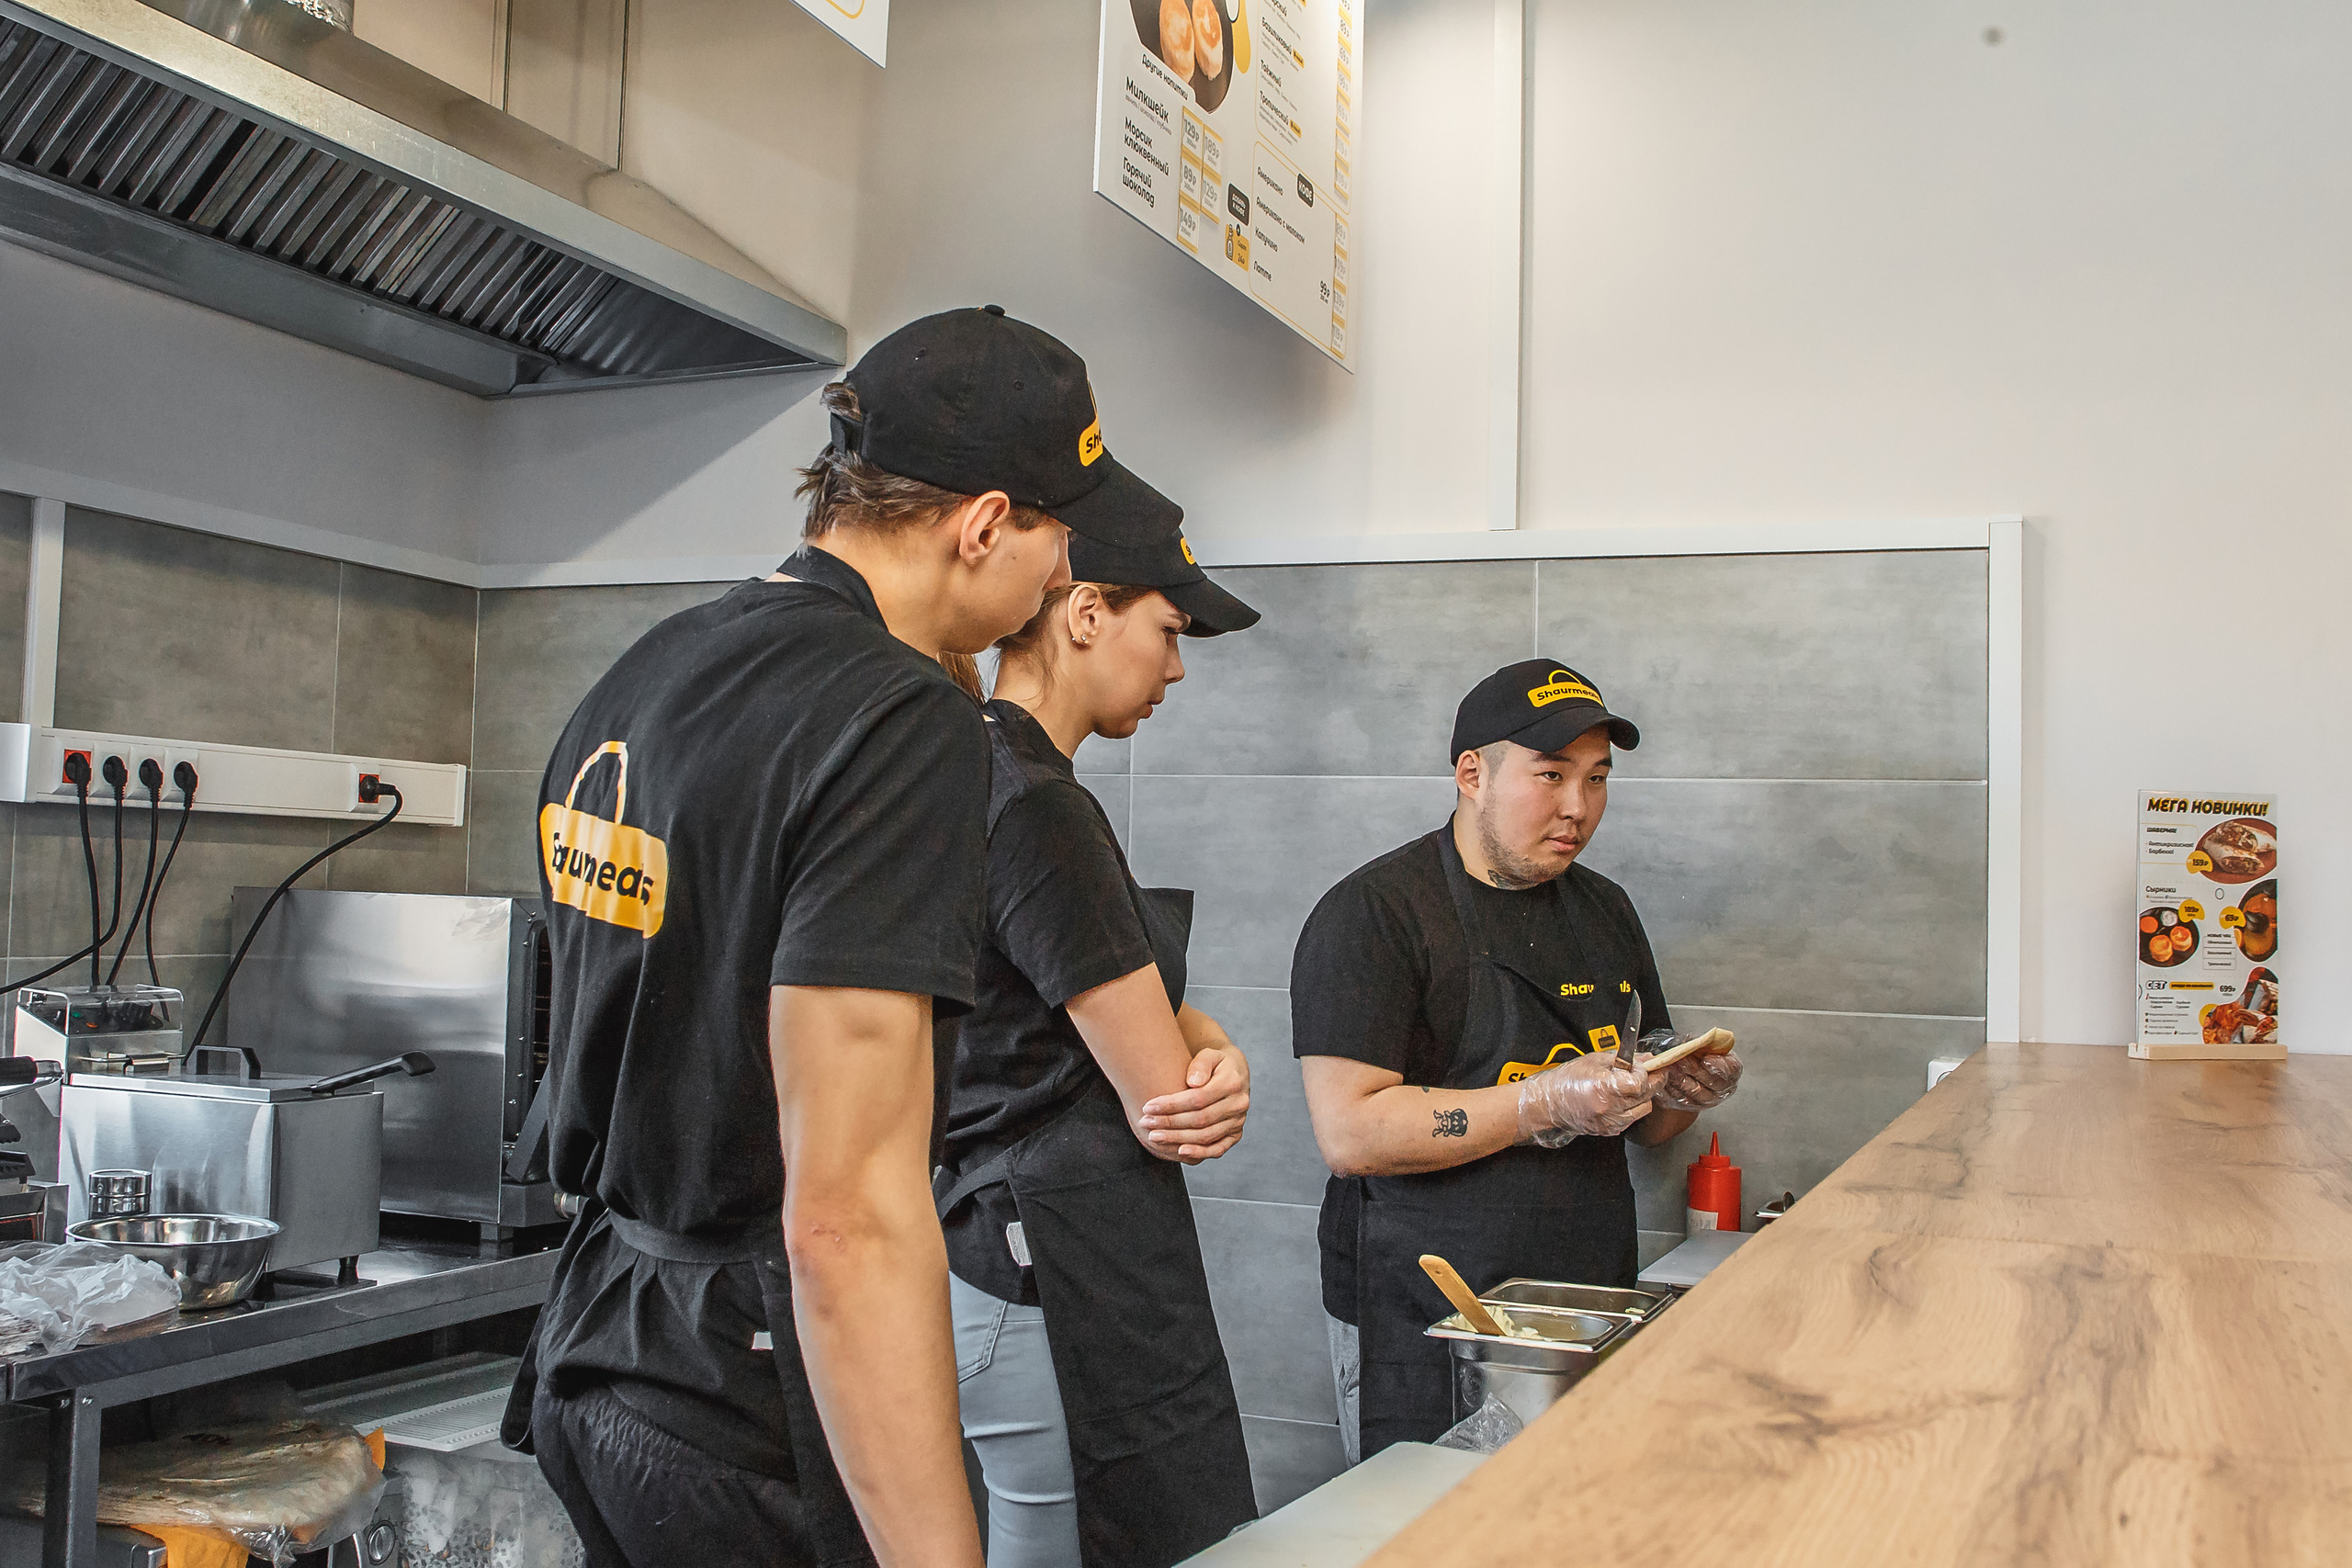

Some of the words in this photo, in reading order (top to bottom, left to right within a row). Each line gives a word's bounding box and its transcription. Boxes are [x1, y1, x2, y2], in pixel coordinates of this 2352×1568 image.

[1142, 53, 1162, 79] Другие
[1163, 73, 1188, 101] напитки
[1125, 75, 1169, 123] Милкшейк
[1125, 117, 1153, 149] Морсик
[1124, 134, 1169, 176] клюквенный
[1123, 156, 1152, 188] Горячий
[1257, 166, 1283, 196] Американо
[1123, 174, 1155, 209] шоколад
[1256, 197, 1283, 226] Американо
[1255, 226, 1278, 253] Капучино
[2147, 797, 2188, 813] МЕГА
[2190, 799, 2269, 817] НОВИНКИ!
[2145, 979, 2167, 990] СЕТ
